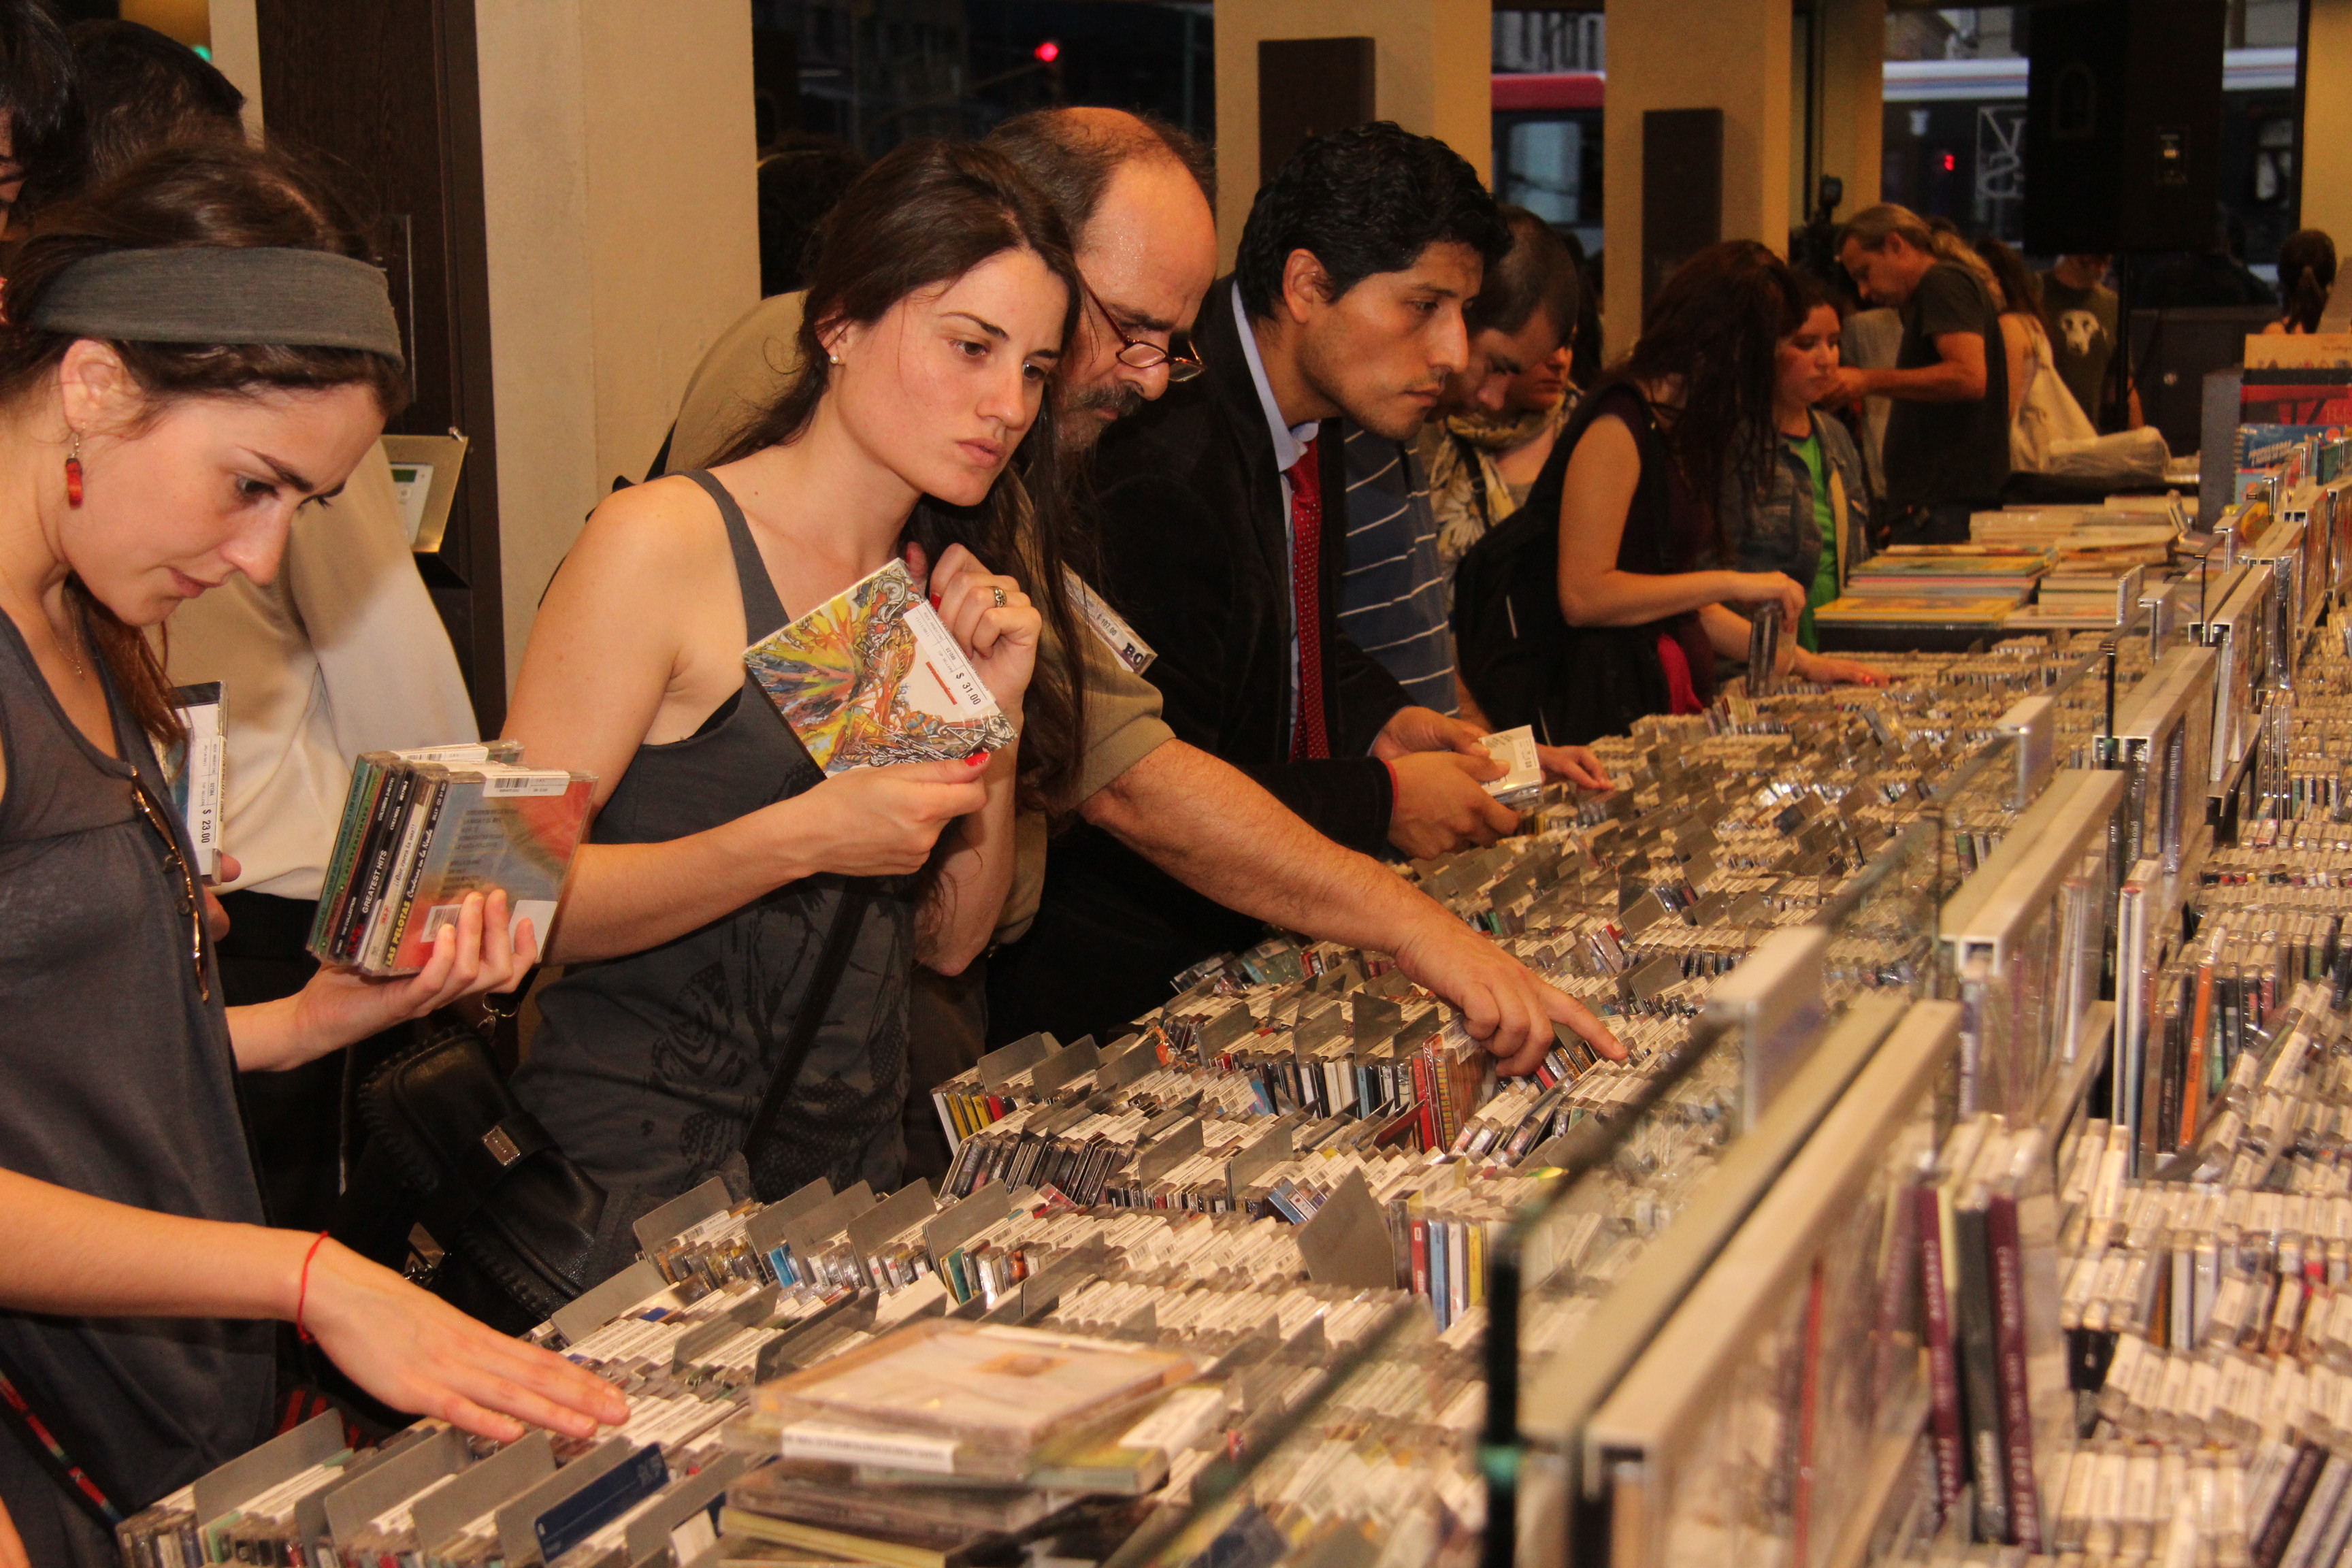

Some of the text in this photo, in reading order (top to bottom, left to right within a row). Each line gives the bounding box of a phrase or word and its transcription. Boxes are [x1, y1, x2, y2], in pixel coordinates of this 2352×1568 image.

[1101, 619, 1117, 636] 107.00
[962, 681, 981, 705] 31.00
[201, 819, 211, 843] 23.00
[361, 849, 388, 914] GREATEST HITS
[345, 896, 357, 926] COLLECTION
[391, 900, 411, 946] PELOTAS
[386, 946, 397, 966] LAS
